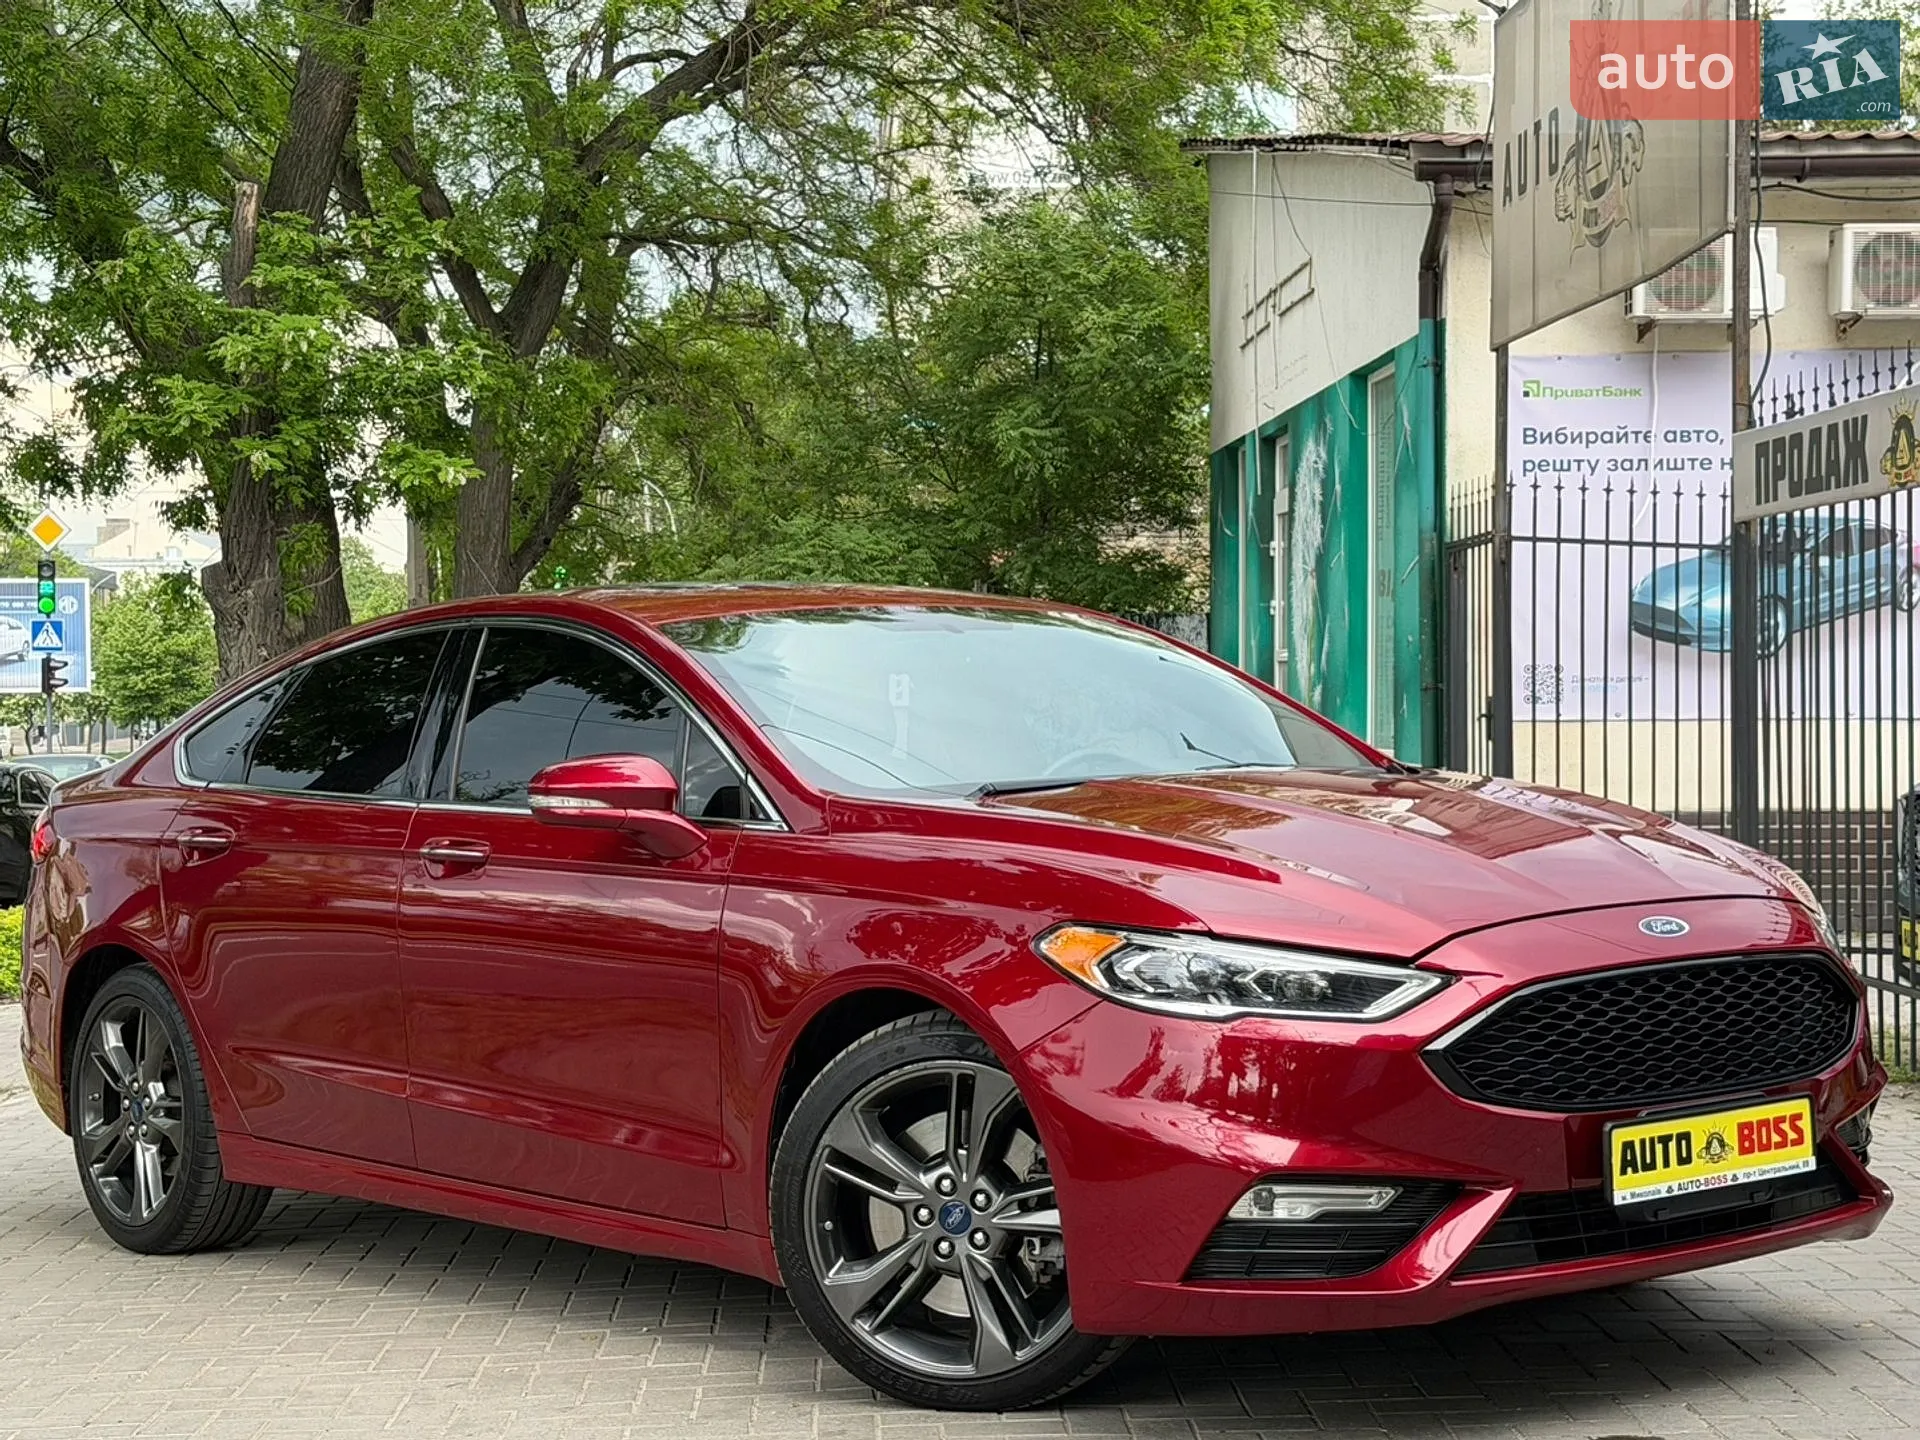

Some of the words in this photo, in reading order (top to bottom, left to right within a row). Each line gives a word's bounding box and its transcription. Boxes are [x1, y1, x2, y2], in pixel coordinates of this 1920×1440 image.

[1502, 106, 1559, 208] AUTO
[1542, 386, 1643, 400] ПриватБанк
[1522, 425, 1656, 449] Вибирайте
[1663, 428, 1724, 446] авто,
[1522, 458, 1600, 477] решту
[1606, 457, 1713, 472] залиште
[1755, 414, 1869, 506] ПРОДАЖ
[1619, 1130, 1693, 1176] AUTO
[1737, 1112, 1805, 1156] BOSS
[1677, 1174, 1728, 1192] AUTO-BOSS
